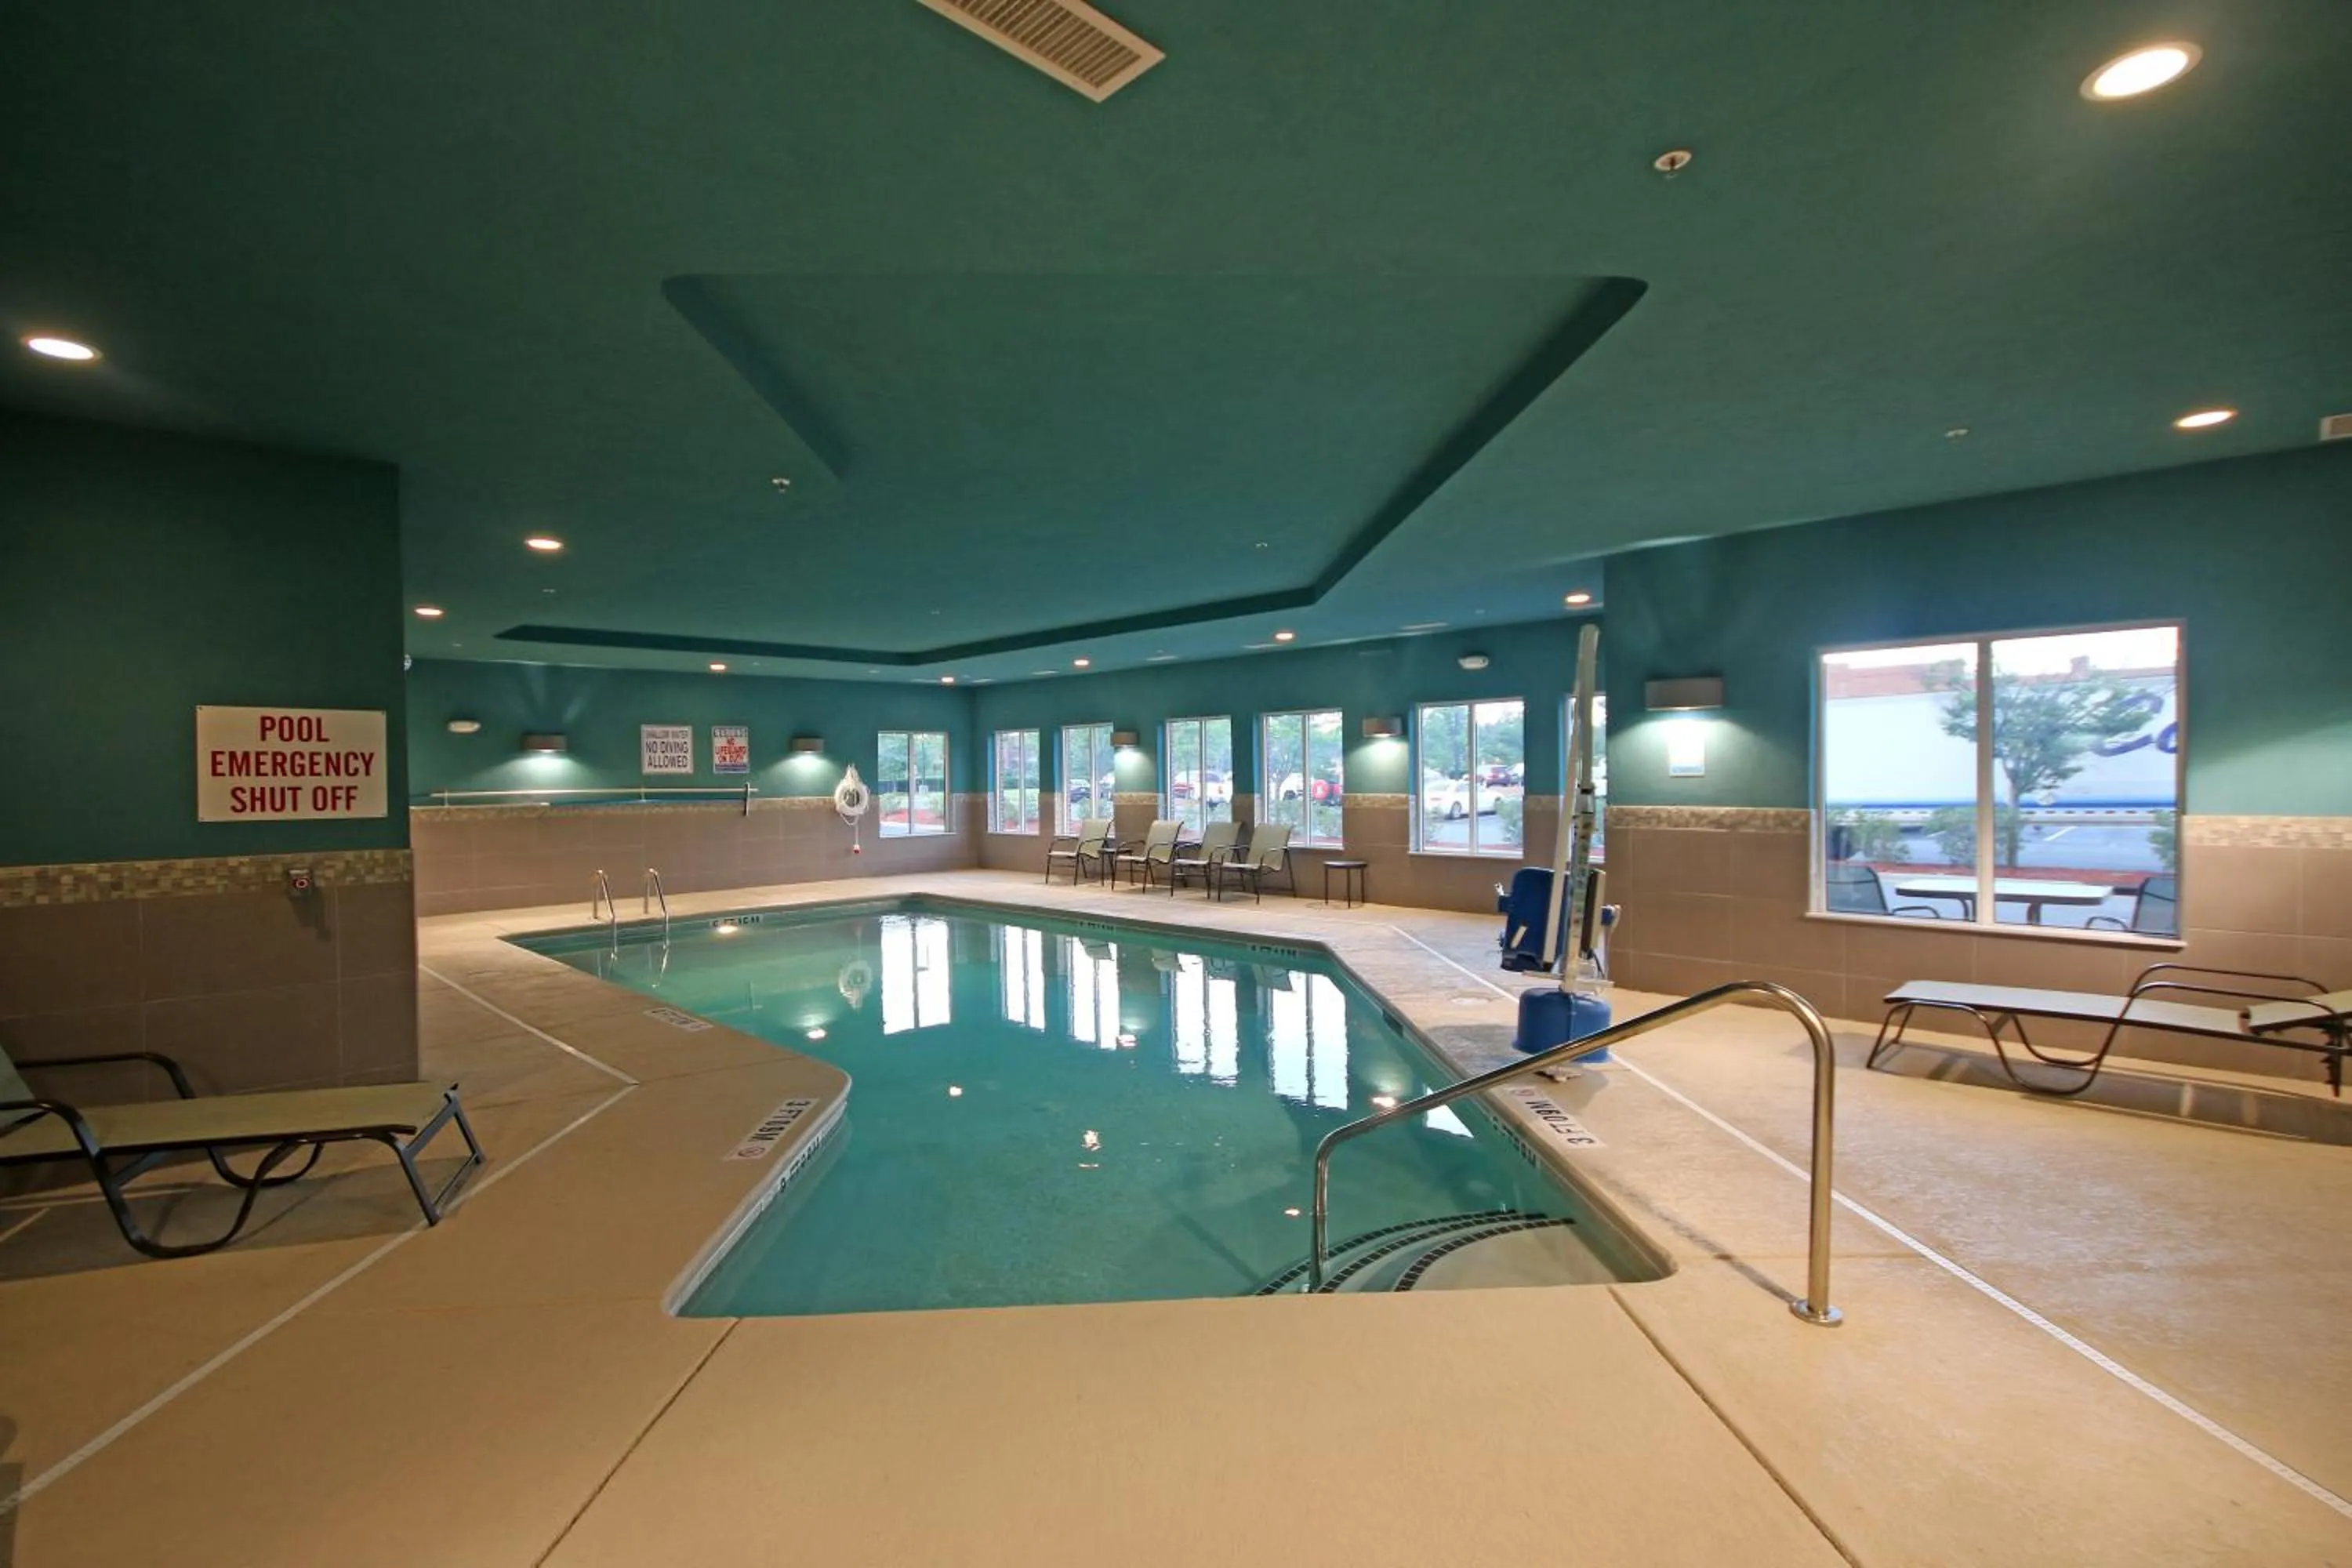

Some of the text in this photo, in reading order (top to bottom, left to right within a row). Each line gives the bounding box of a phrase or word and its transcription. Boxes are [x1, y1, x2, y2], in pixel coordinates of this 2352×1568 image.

[260, 716, 331, 742] POOL
[646, 741, 688, 753] NO DIVING
[210, 750, 375, 778] EMERGENCY
[648, 755, 688, 768] ALLOWED
[230, 786, 358, 813] SHUT OFF
